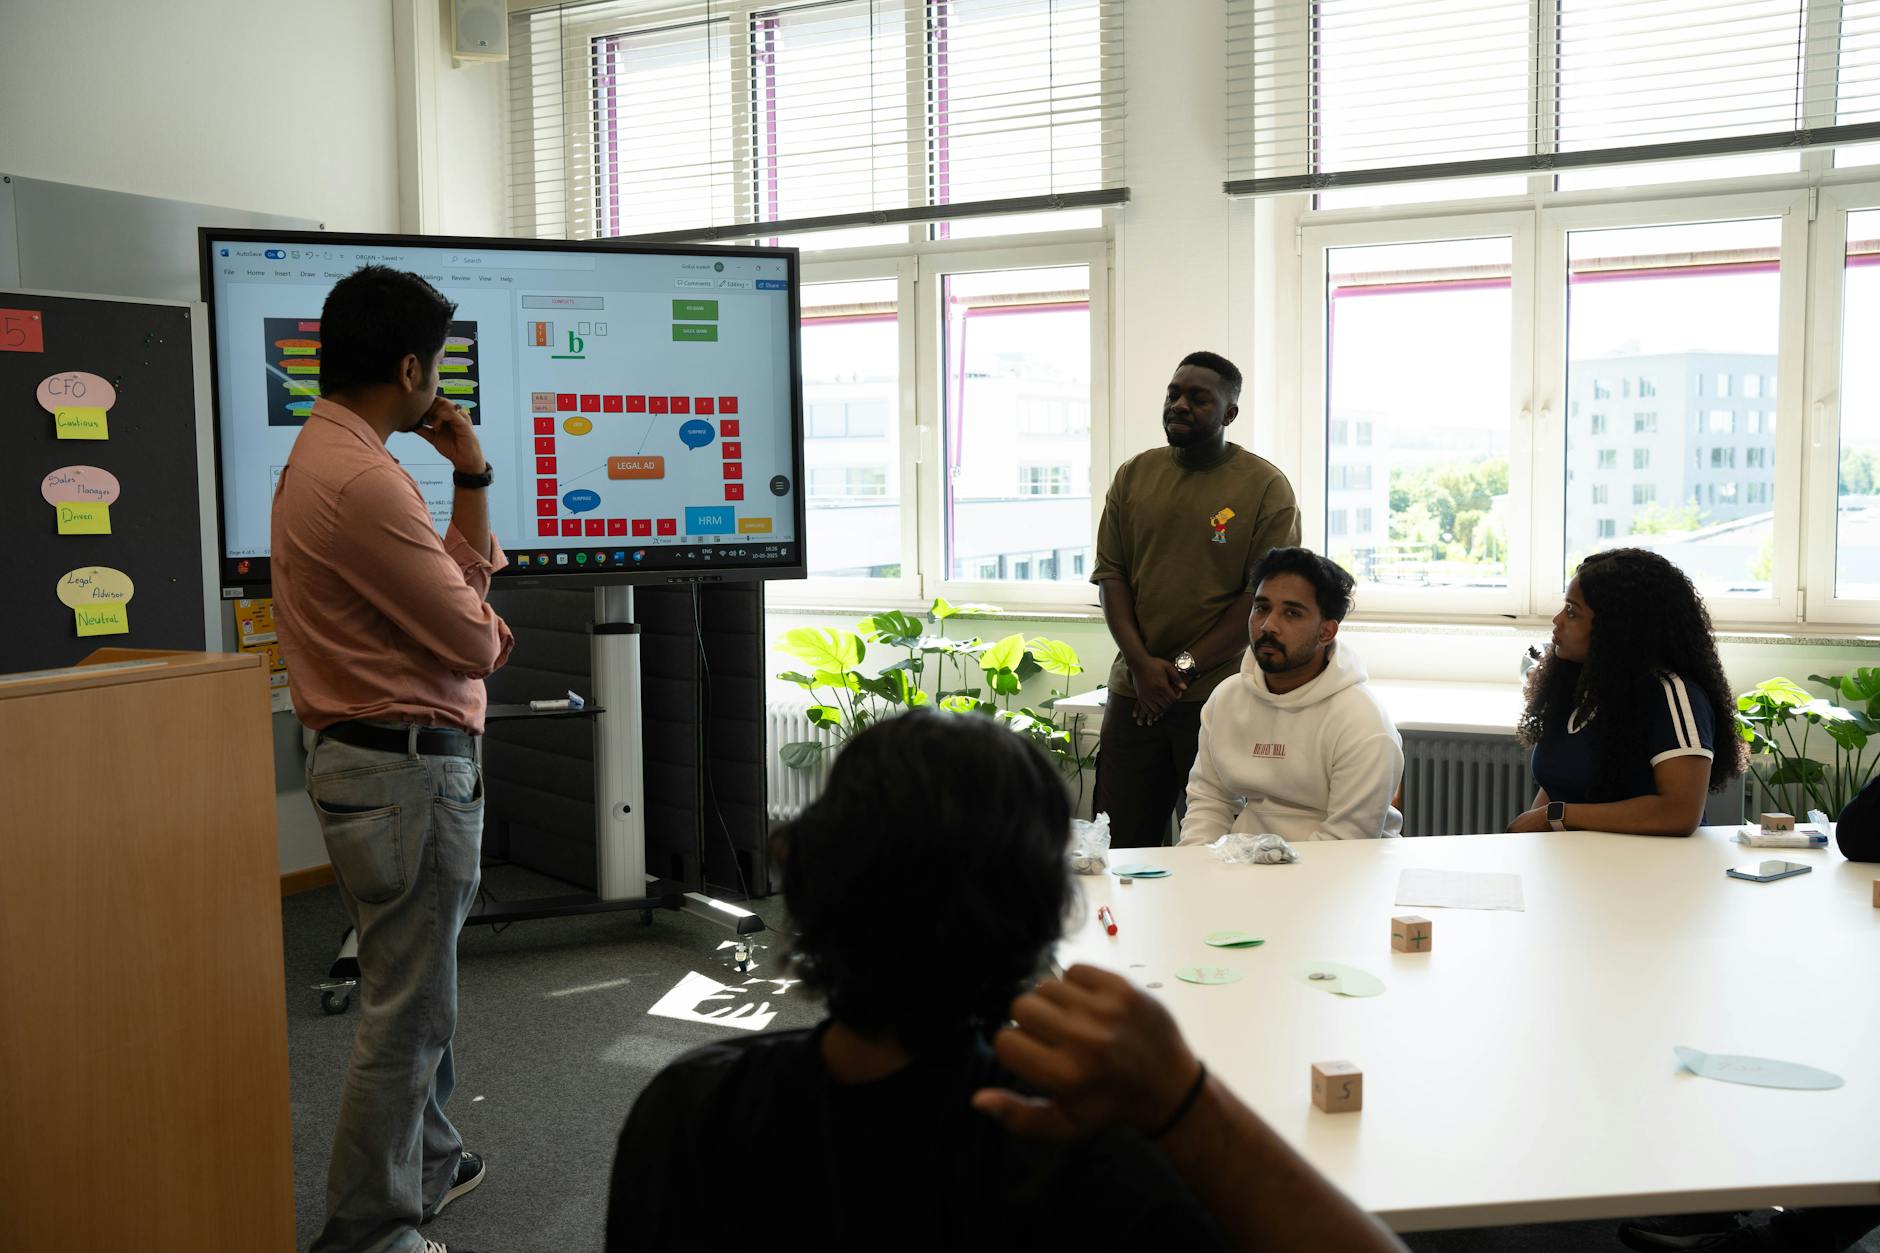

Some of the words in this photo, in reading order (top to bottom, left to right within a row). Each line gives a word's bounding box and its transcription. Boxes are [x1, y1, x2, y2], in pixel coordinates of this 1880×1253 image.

[223, 268, 235, 276] File
[247, 268, 266, 276] Home
[324, 271, 344, 279] Design
[727, 281, 745, 289] Editing
[4, 317, 26, 347] 5
[568, 330, 584, 353] b
[48, 377, 86, 398] CFO
[617, 462, 641, 470] LEGAL
[644, 461, 655, 470] AD
[48, 474, 76, 487] Sales
[61, 507, 93, 523] Driven
[698, 515, 722, 525] HRM
[67, 572, 92, 588] Legal
[92, 586, 124, 599] Advisor
[77, 612, 119, 627] Neutral
